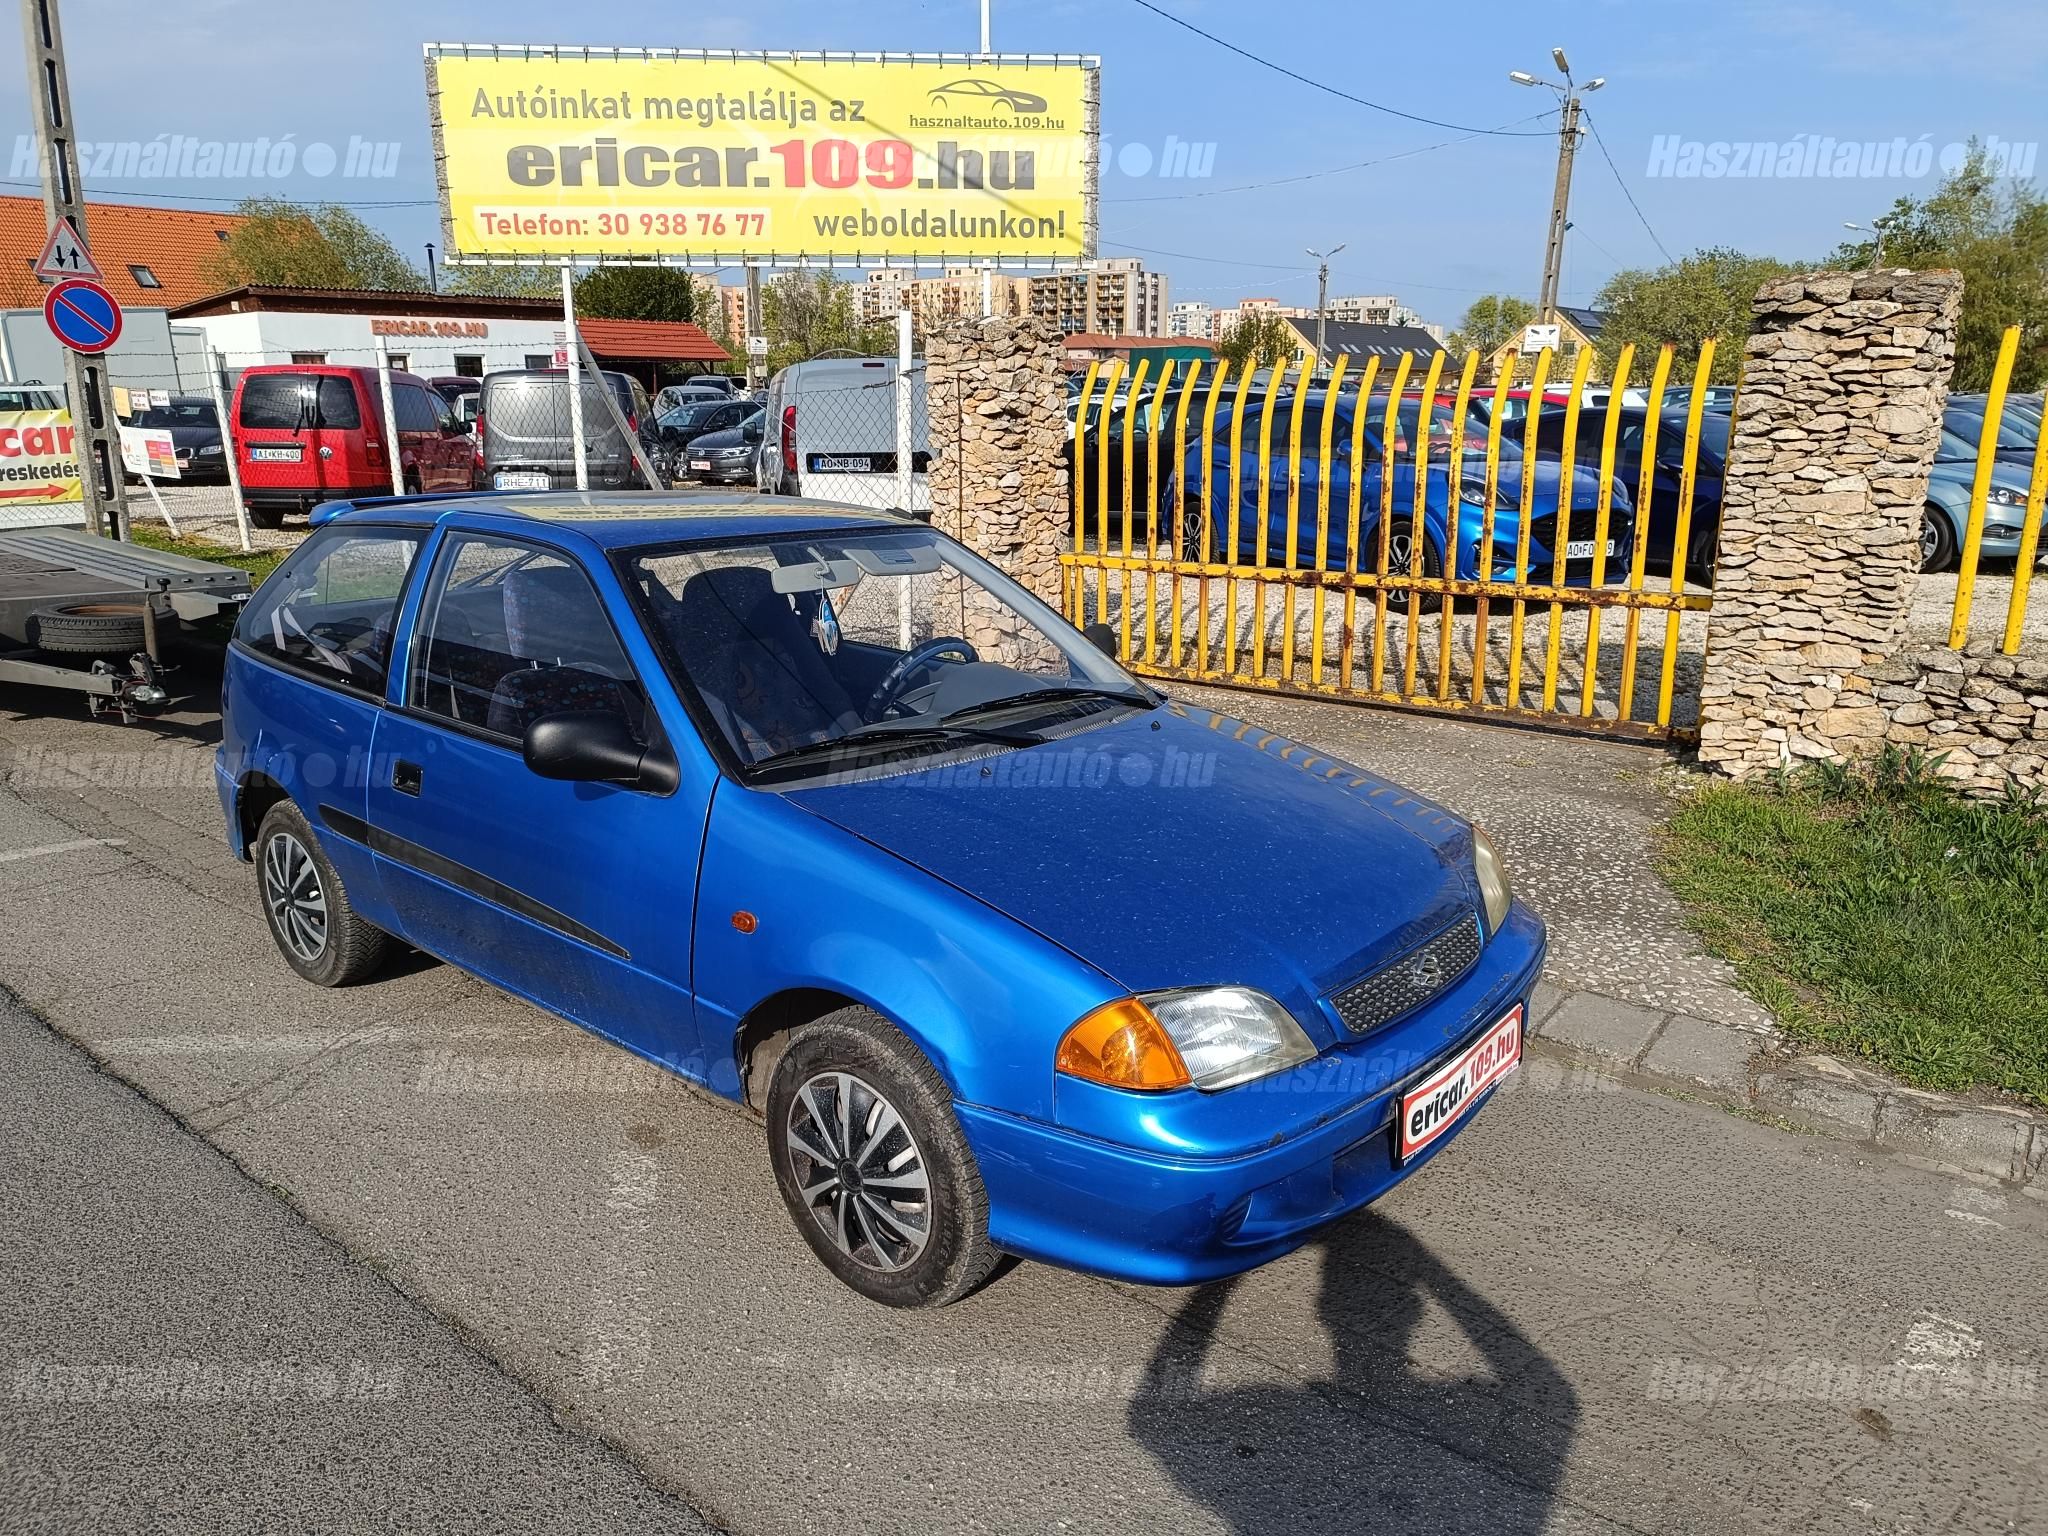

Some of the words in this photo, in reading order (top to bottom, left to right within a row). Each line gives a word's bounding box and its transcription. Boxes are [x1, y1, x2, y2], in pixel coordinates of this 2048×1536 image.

[471, 85, 632, 119] Autóinkat
[644, 87, 817, 128] megtalálja
[829, 99, 865, 121] az
[909, 114, 1065, 130] hasznaltauto.109.hu
[507, 137, 1035, 190] ericar.109.hu
[480, 212, 589, 235] Telefon:
[598, 213, 630, 235] 30
[639, 213, 688, 236] 938
[697, 213, 726, 235] 76
[735, 213, 765, 235] 77
[813, 208, 1065, 238] weboldalunkon!
[371, 319, 489, 339] ERICAR.109.HU
[1411, 1027, 1516, 1137] ericar.109.hu
